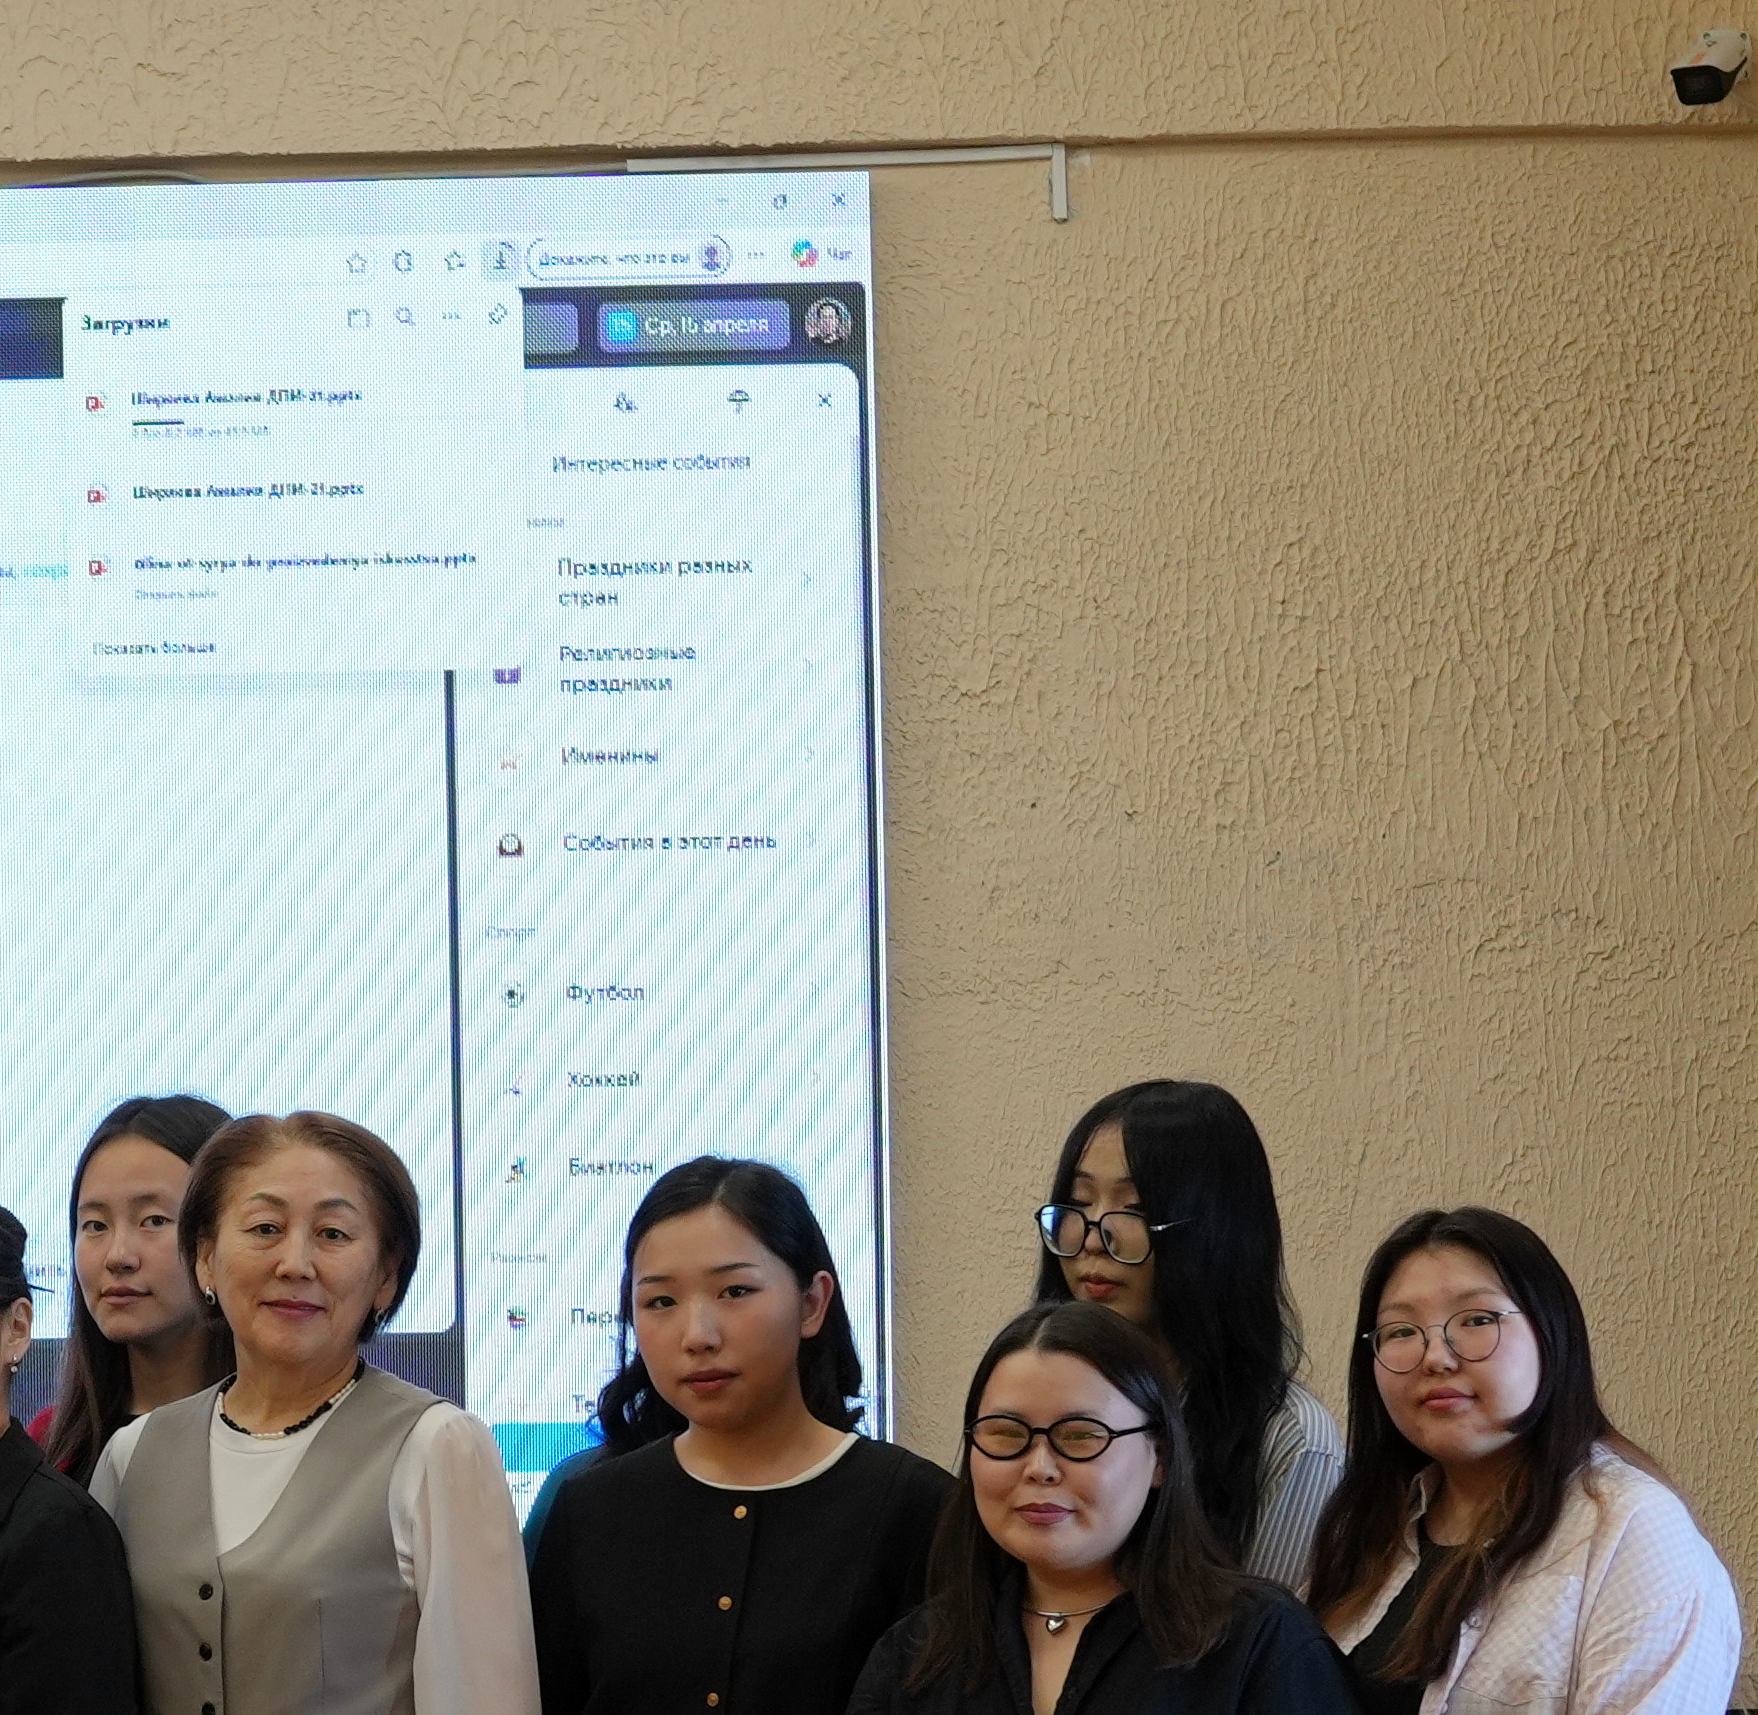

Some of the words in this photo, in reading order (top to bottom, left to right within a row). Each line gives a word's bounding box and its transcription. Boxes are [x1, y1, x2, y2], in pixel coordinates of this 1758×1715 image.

[81, 315, 170, 336] Загрузки
[702, 316, 770, 334] апреля
[552, 454, 668, 475] Интересные
[672, 452, 752, 473] события
[557, 557, 672, 581] Праздники
[676, 558, 754, 579] разных
[558, 589, 620, 609] стран
[559, 644, 697, 666] Религиозные
[560, 675, 673, 697] праздники
[561, 744, 660, 766] Именины
[563, 832, 655, 855] События
[660, 836, 673, 851] в
[676, 834, 723, 851] этот
[726, 833, 778, 855] день
[565, 983, 646, 1006] Футбол
[566, 1069, 643, 1090] Хоккей
[568, 1156, 656, 1177] Биатлон
